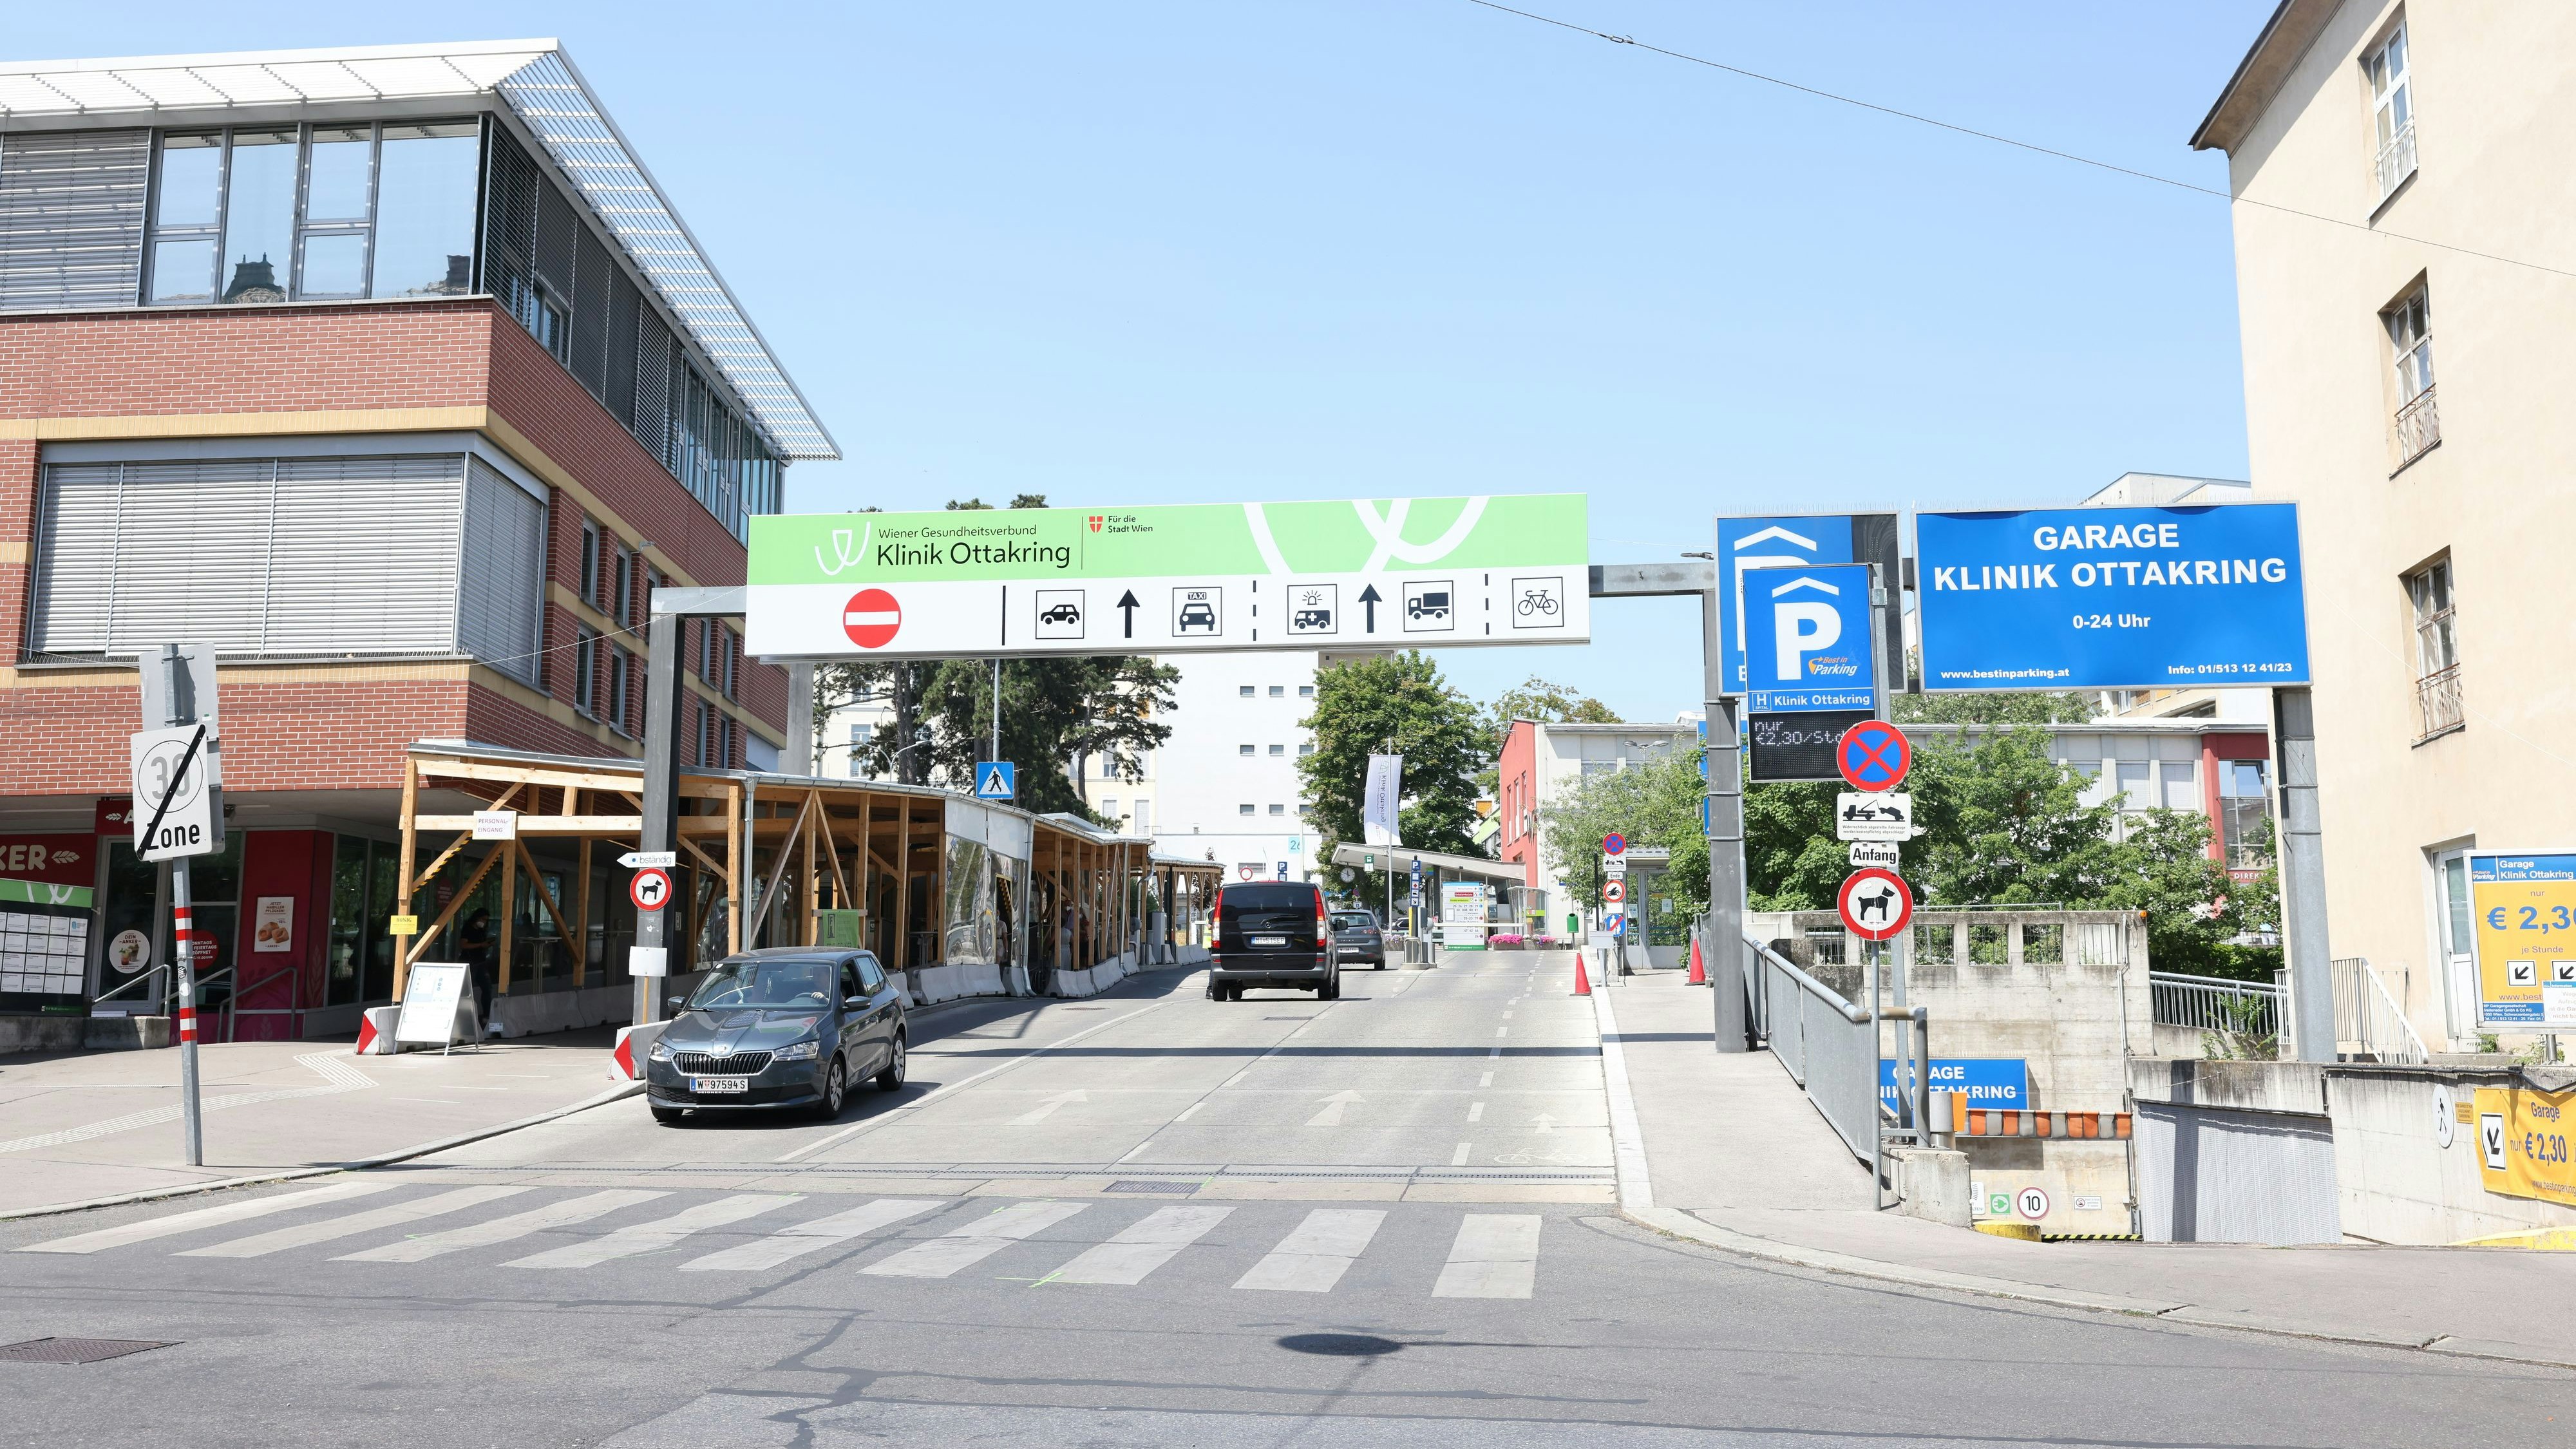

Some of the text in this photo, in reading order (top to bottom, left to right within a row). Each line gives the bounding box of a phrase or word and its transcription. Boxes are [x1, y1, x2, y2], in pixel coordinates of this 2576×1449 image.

[878, 524, 1036, 538] Wiener Gesundheitsverbund
[2033, 524, 2180, 551] GARAGE
[877, 540, 1070, 569] Klinik Ottakring
[1934, 558, 2287, 591] KLINIK OTTAKRING
[2072, 614, 2151, 629] 0-24 Uhr
[1774, 601, 1842, 681] P
[1813, 664, 1858, 676] Parking
[1940, 668, 2070, 679] www.bestinparking.at
[2168, 663, 2293, 674] Info: 01/513 12 41/23
[1756, 694, 1767, 706] H
[1774, 694, 1870, 706] Klinik Ottakring
[1754, 721, 1784, 732] nur
[151, 753, 191, 800] 30
[1852, 848, 1897, 864] Anfang
[2499, 860, 2535, 869] Garage
[2501, 871, 2574, 880] Klinik Ottakring
[2486, 905, 2576, 935] € 2,3
[2521, 946, 2529, 955] je
[697, 1080, 704, 1089] W
[710, 1080, 738, 1089] 97594
[2531, 1101, 2560, 1122] Garage
[2510, 1139, 2521, 1151] nur
[2525, 1132, 2533, 1159] €
[2537, 1133, 2567, 1167] 2,30
[2025, 1195, 2040, 1211] 10
